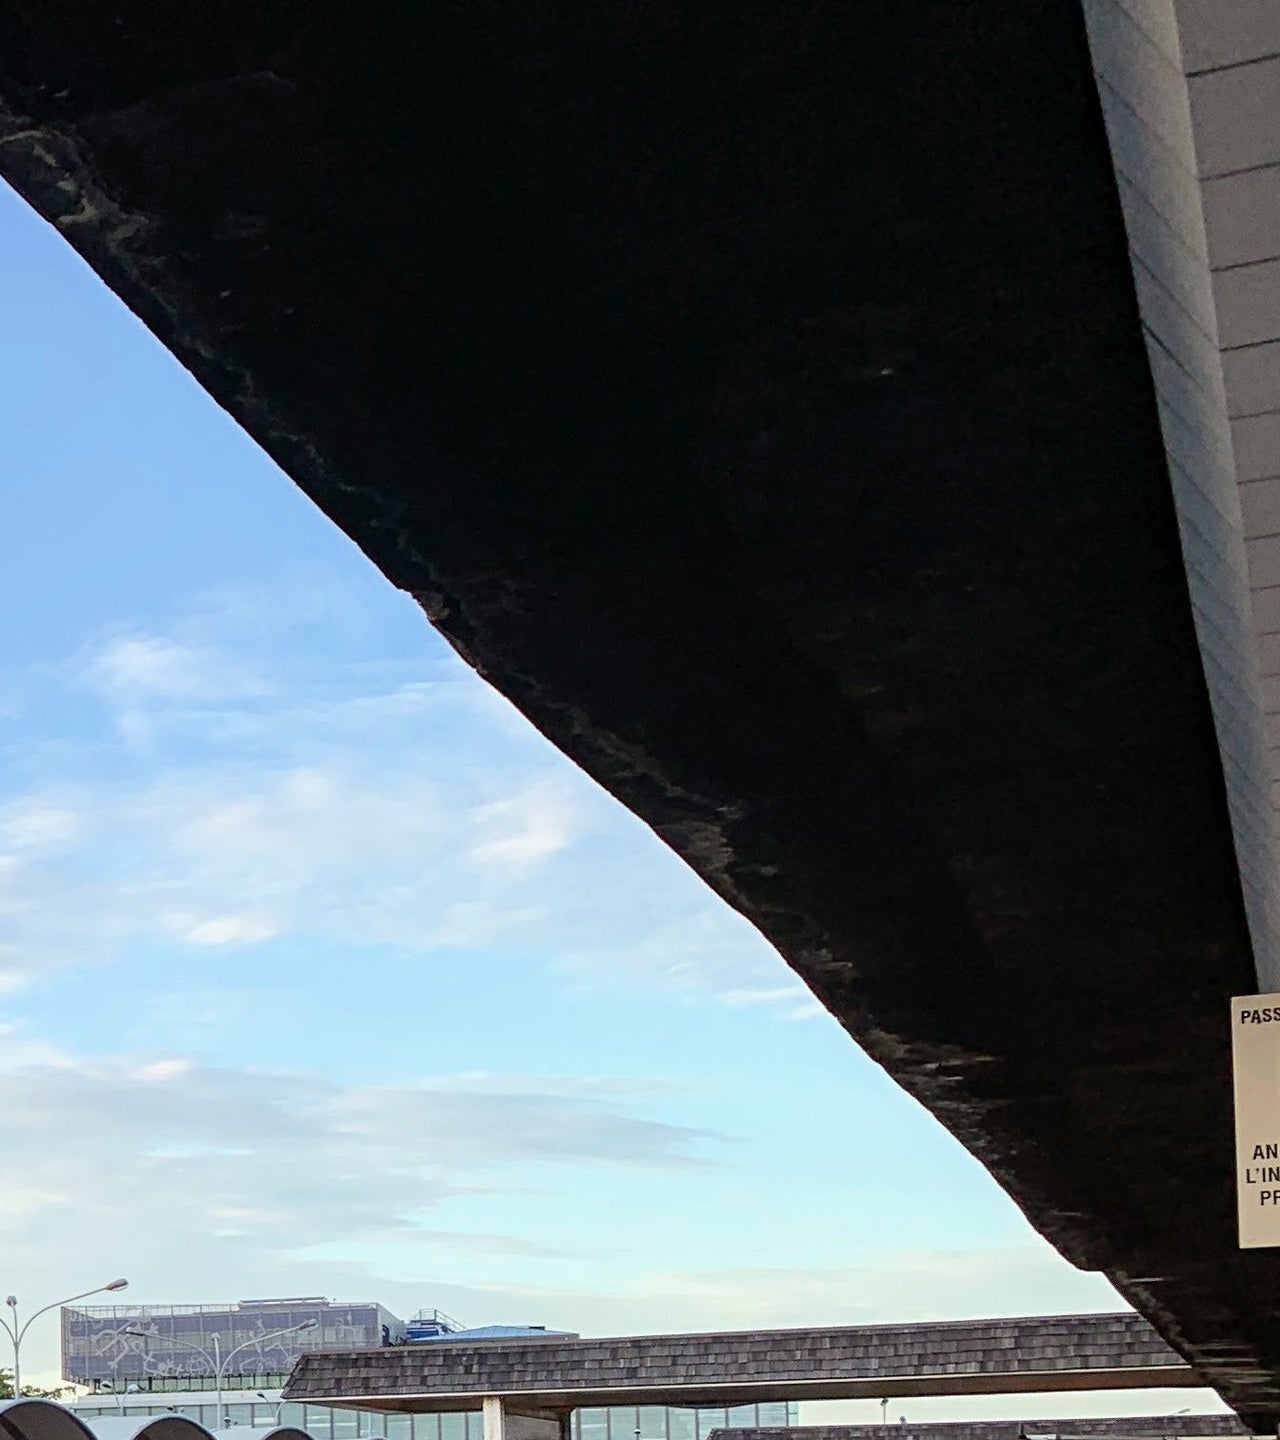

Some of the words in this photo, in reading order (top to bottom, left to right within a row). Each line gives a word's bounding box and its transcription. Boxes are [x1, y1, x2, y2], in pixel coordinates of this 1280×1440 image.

[1241, 1007, 1280, 1024] PASS
[1252, 1143, 1278, 1160] AN
[1246, 1167, 1280, 1183] L'IN
